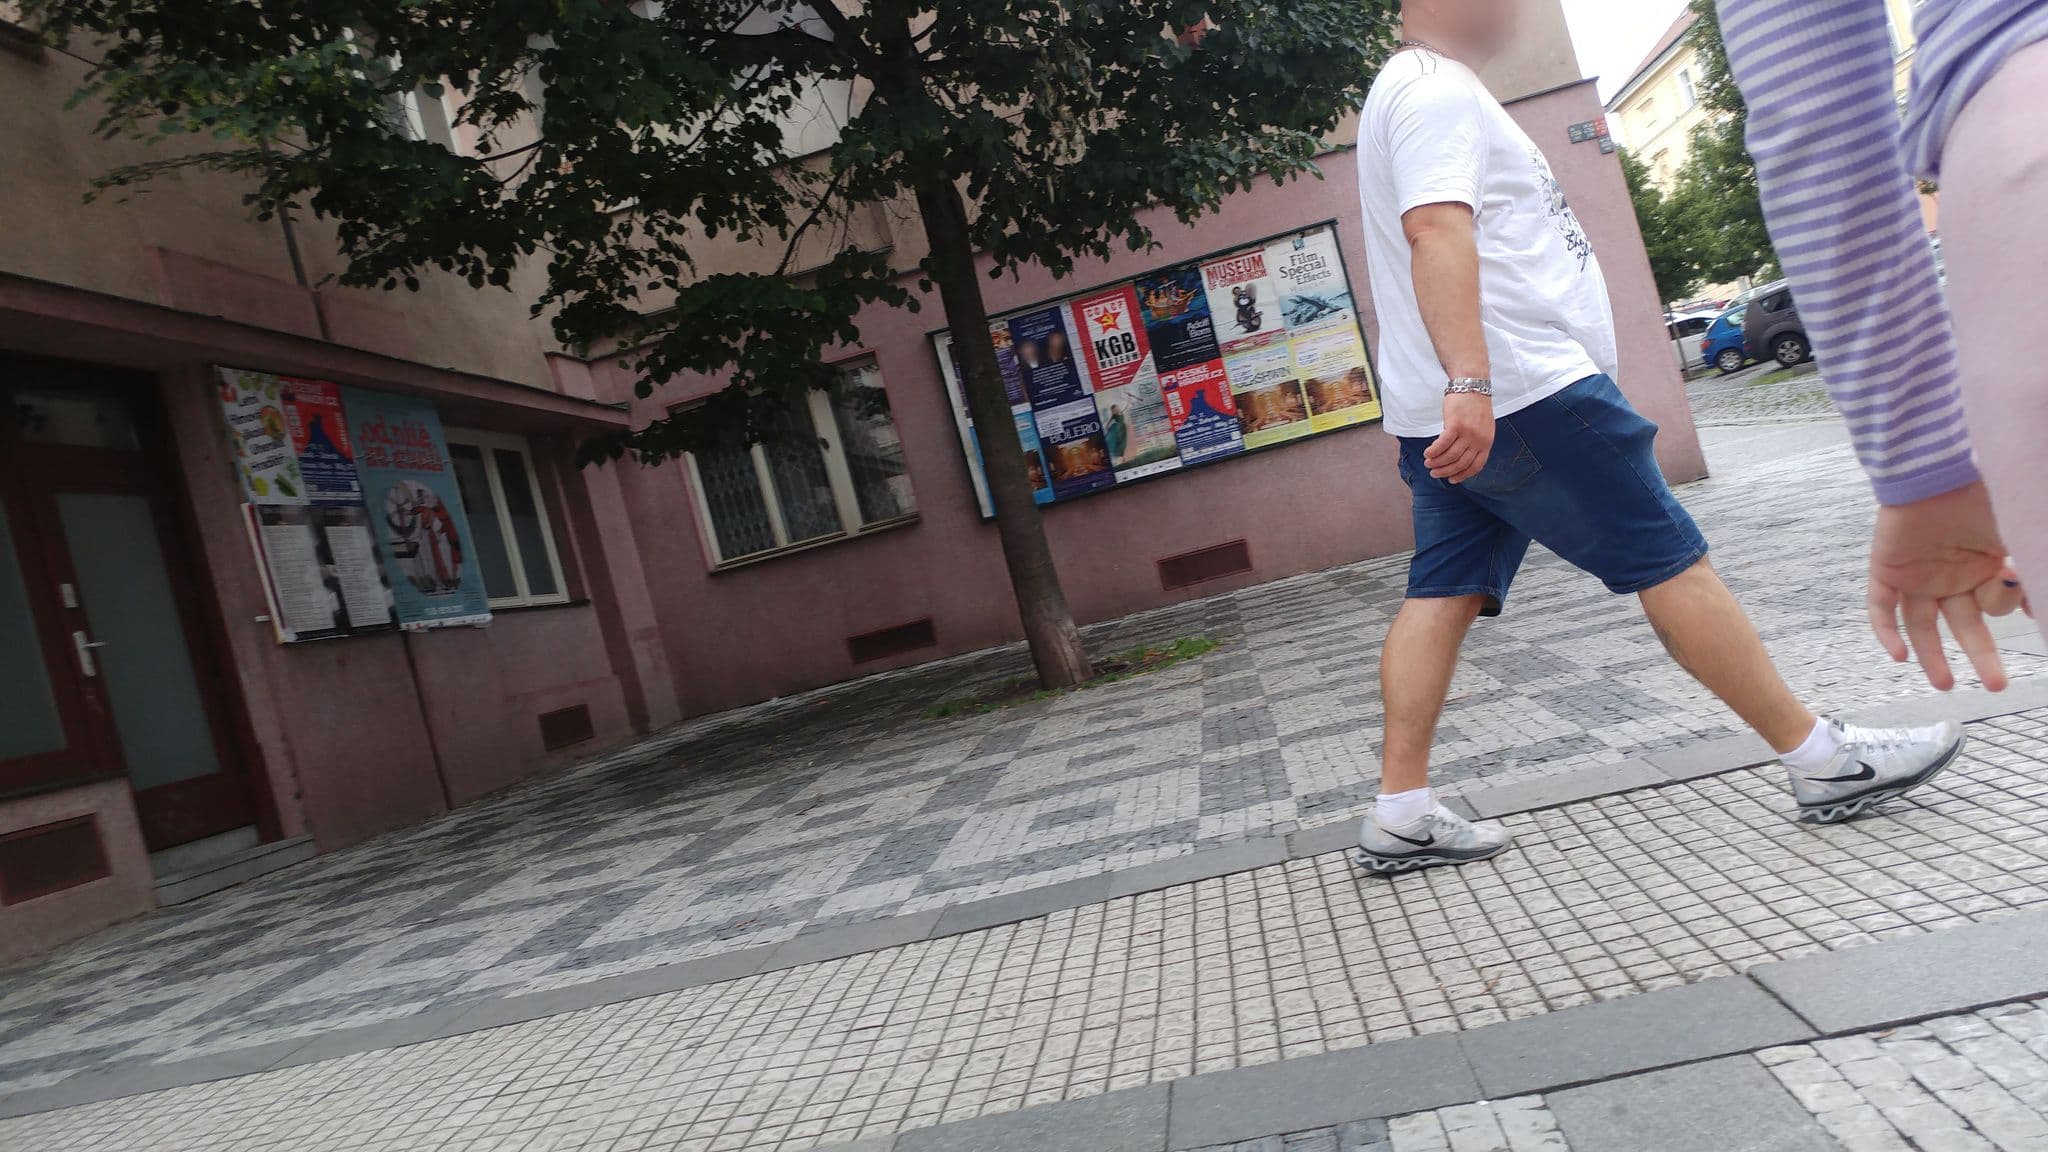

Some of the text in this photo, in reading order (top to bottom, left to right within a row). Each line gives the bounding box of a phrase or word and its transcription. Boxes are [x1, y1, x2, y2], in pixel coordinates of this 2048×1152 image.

[1206, 255, 1265, 283] MUSEUM
[1279, 256, 1327, 280] Special
[1290, 252, 1318, 267] Film
[1208, 268, 1268, 291] OF COMMUNISM
[1296, 269, 1332, 286] Effects
[1095, 332, 1136, 361] KGB
[1237, 365, 1292, 389] SHWIN
[1050, 421, 1100, 444] BOLERO
